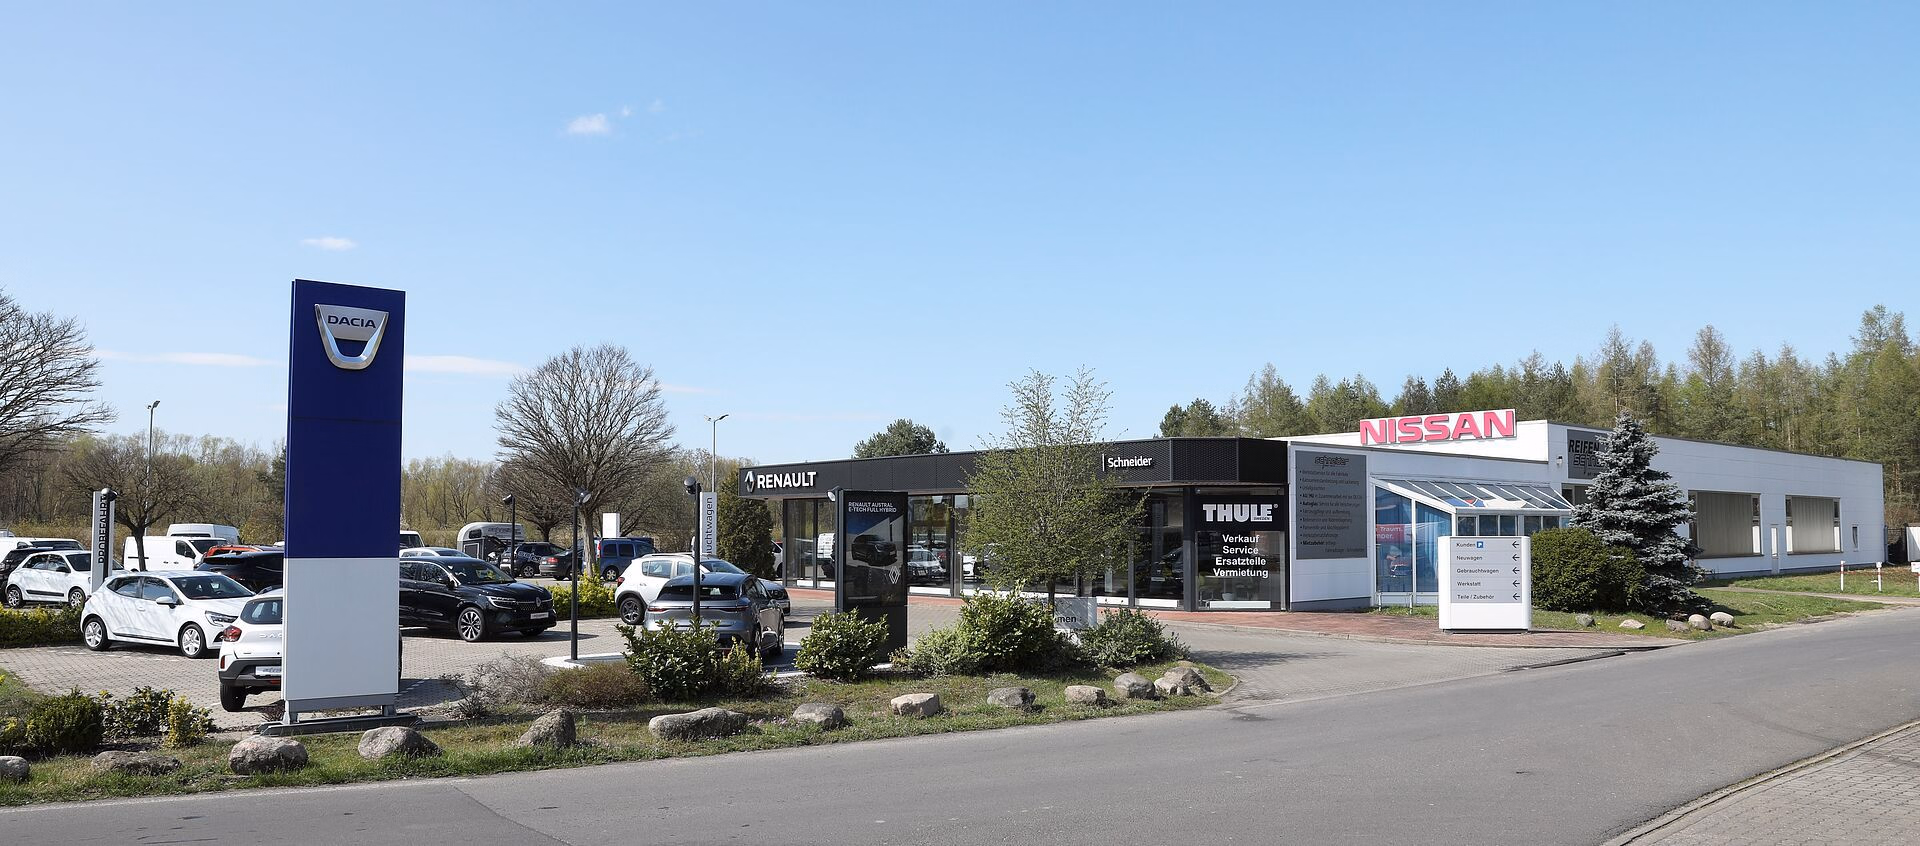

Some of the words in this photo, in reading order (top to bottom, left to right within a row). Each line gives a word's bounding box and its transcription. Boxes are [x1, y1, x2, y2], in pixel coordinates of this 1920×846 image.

[327, 315, 377, 328] DACIA
[1360, 410, 1515, 446] NISSAN
[1568, 439, 1600, 454] REIFEN
[1107, 455, 1153, 468] Schneider
[757, 471, 817, 489] RENAULT
[1202, 503, 1273, 522] THULE
[1222, 533, 1260, 543] Verkauf
[1222, 545, 1259, 554] Service
[1215, 556, 1267, 566] Ersatzteile
[1213, 567, 1270, 579] Vermietung
